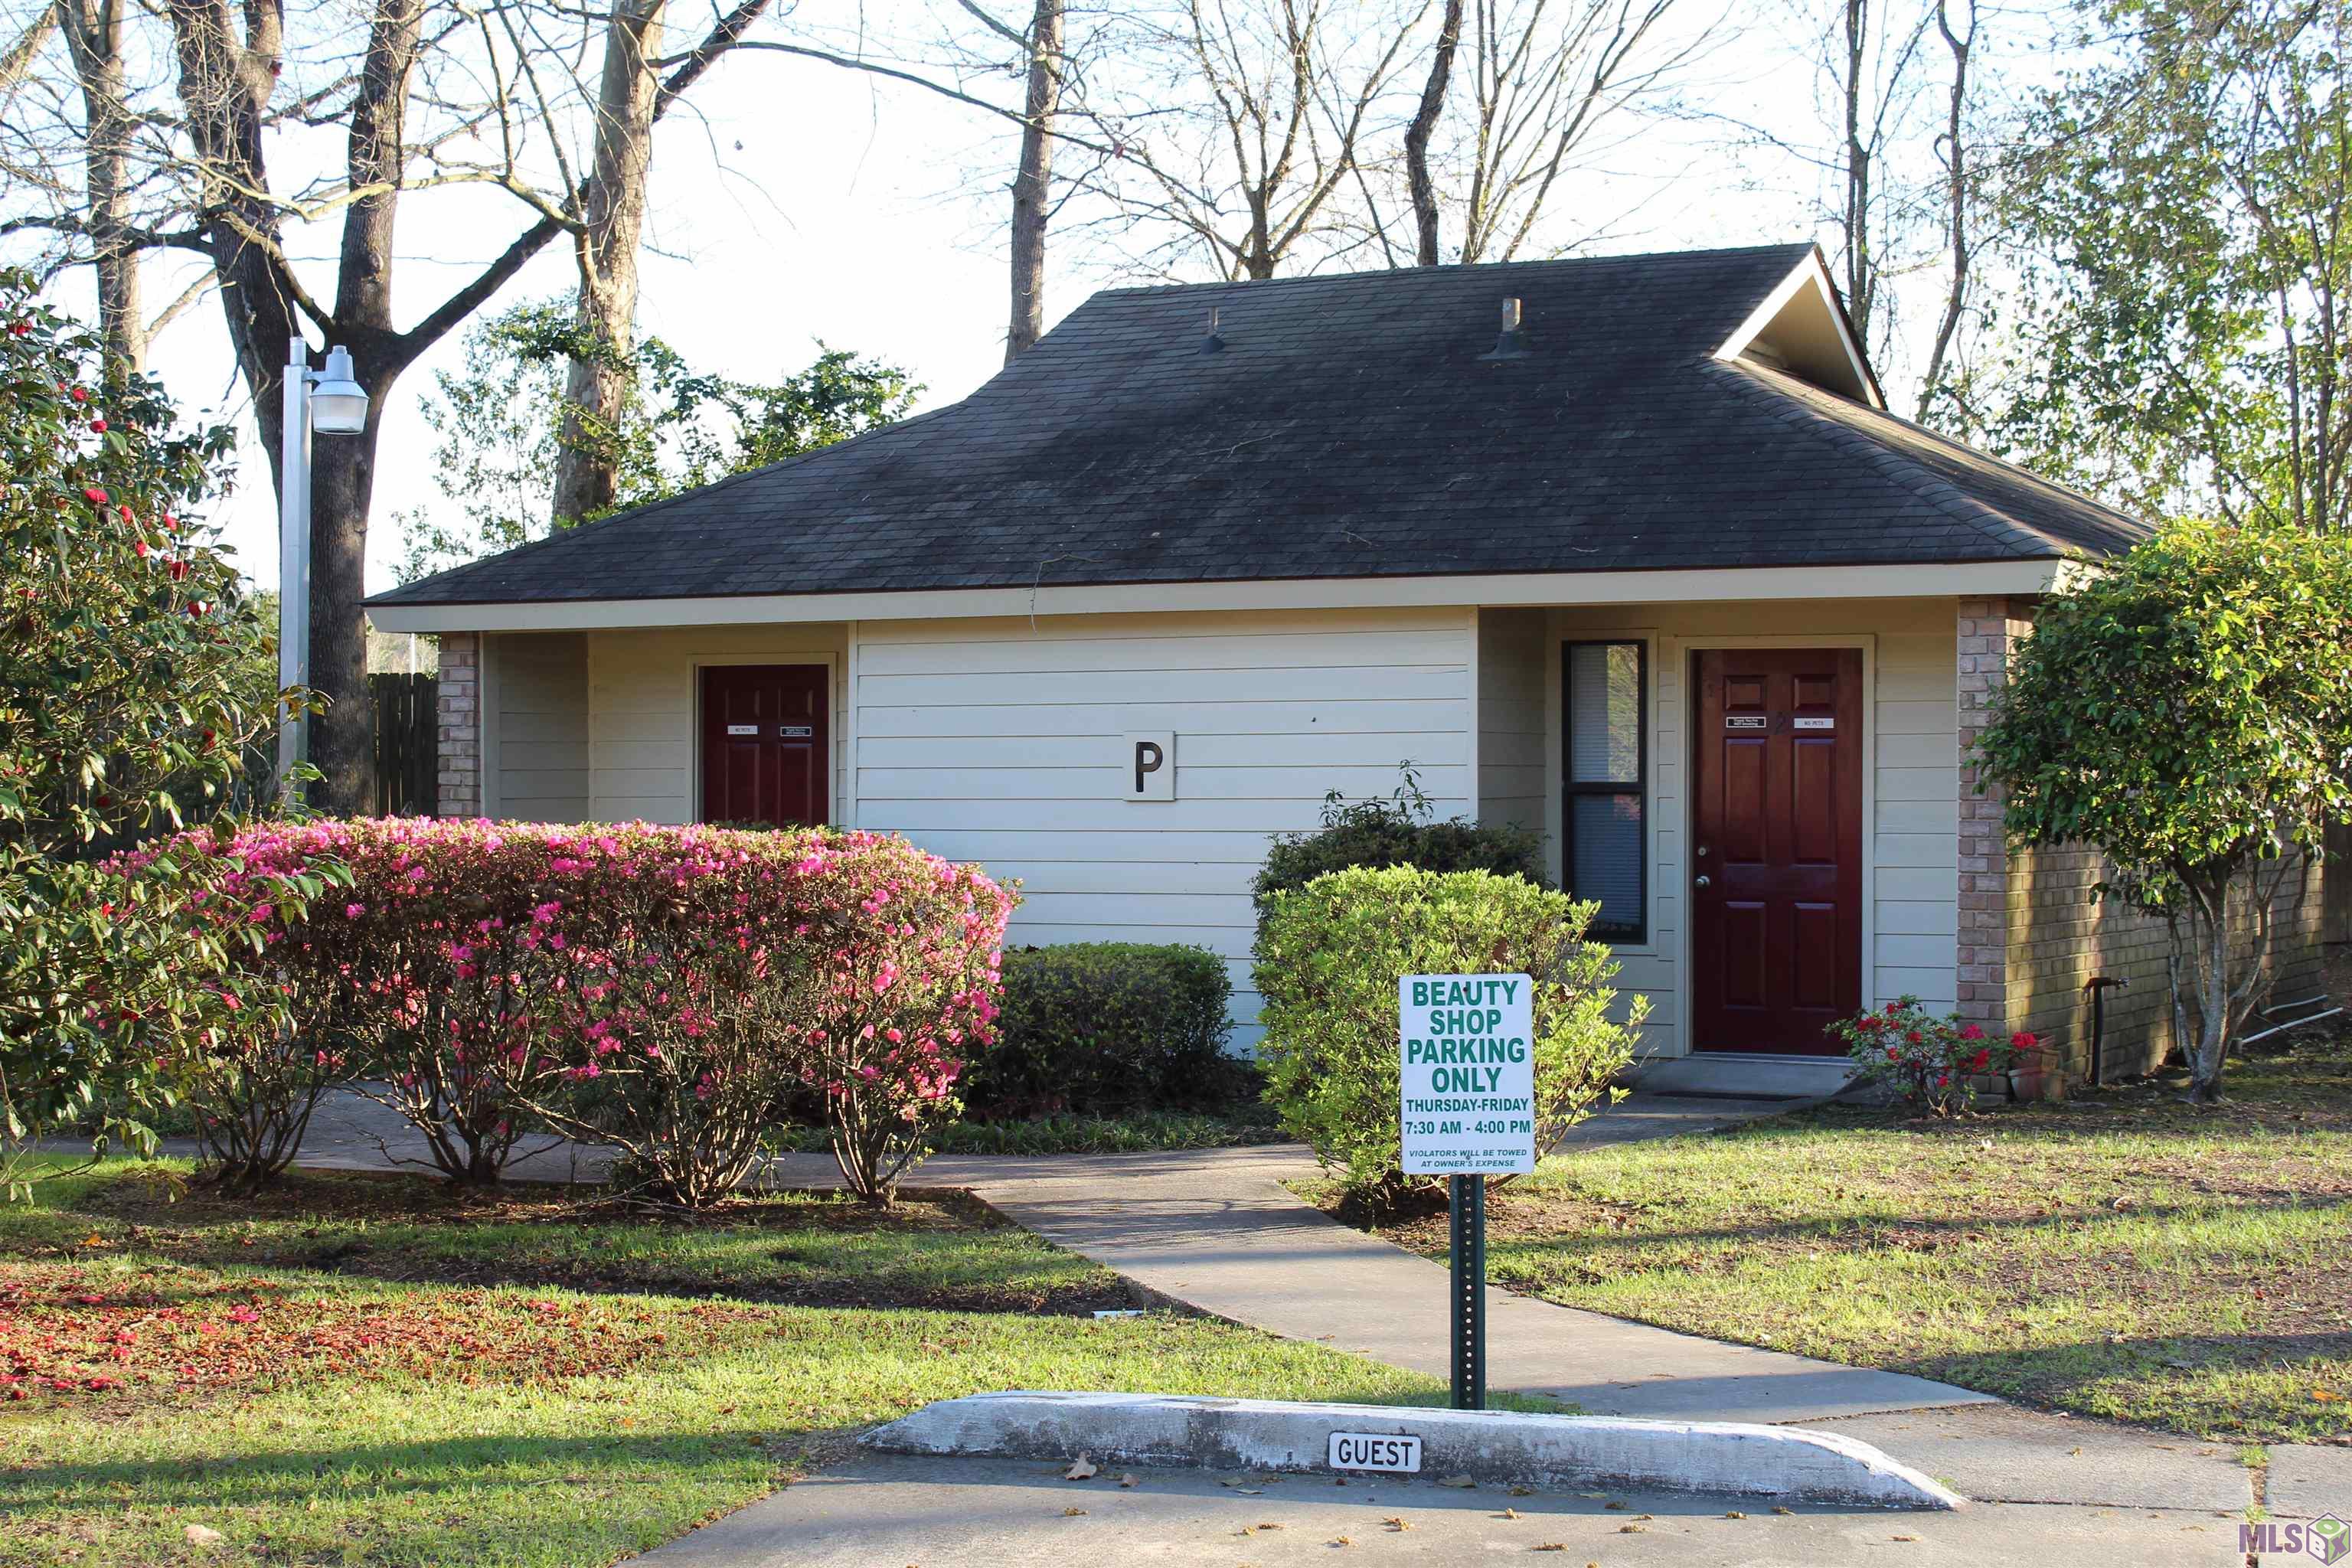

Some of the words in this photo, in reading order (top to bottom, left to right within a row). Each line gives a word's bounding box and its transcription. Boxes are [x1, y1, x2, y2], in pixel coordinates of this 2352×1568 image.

[1135, 742, 1163, 792] P
[1413, 980, 1518, 1007] BEAUTY
[1429, 1009, 1501, 1035] SHOP
[1408, 1037, 1525, 1064] PARKING
[1432, 1067, 1502, 1093] ONLY
[1406, 1099, 1529, 1112] THURSDAY-FRIDAY
[1405, 1121, 1435, 1134] 7:30
[1439, 1121, 1462, 1134] AM
[1475, 1121, 1504, 1134] 4:00
[1510, 1120, 1530, 1133] PM
[1338, 1439, 1413, 1466] GUEST
